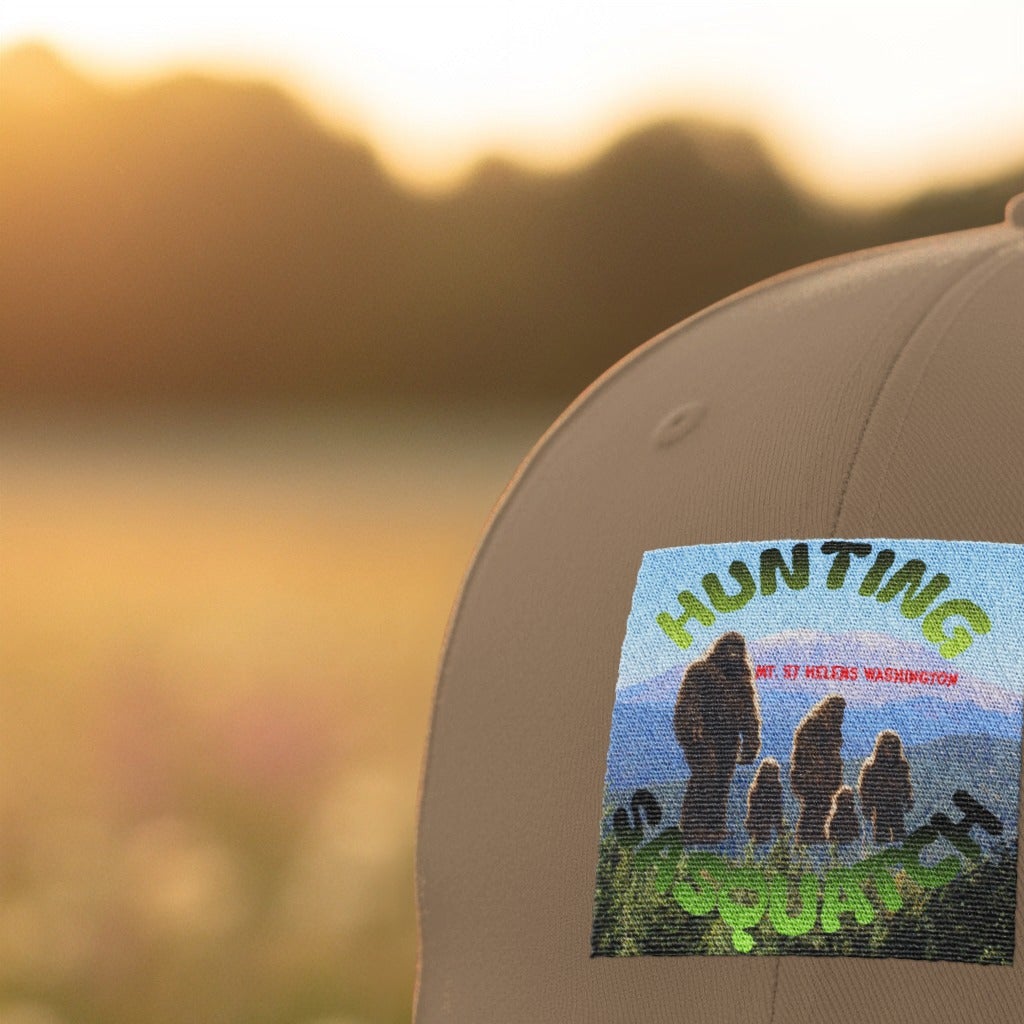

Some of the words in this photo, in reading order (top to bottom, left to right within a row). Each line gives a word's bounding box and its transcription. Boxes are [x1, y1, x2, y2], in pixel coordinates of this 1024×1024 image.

[655, 541, 992, 660] HUNTING
[783, 664, 800, 680] ST
[805, 664, 859, 681] HELENS
[863, 667, 959, 687] WASHINGTON
